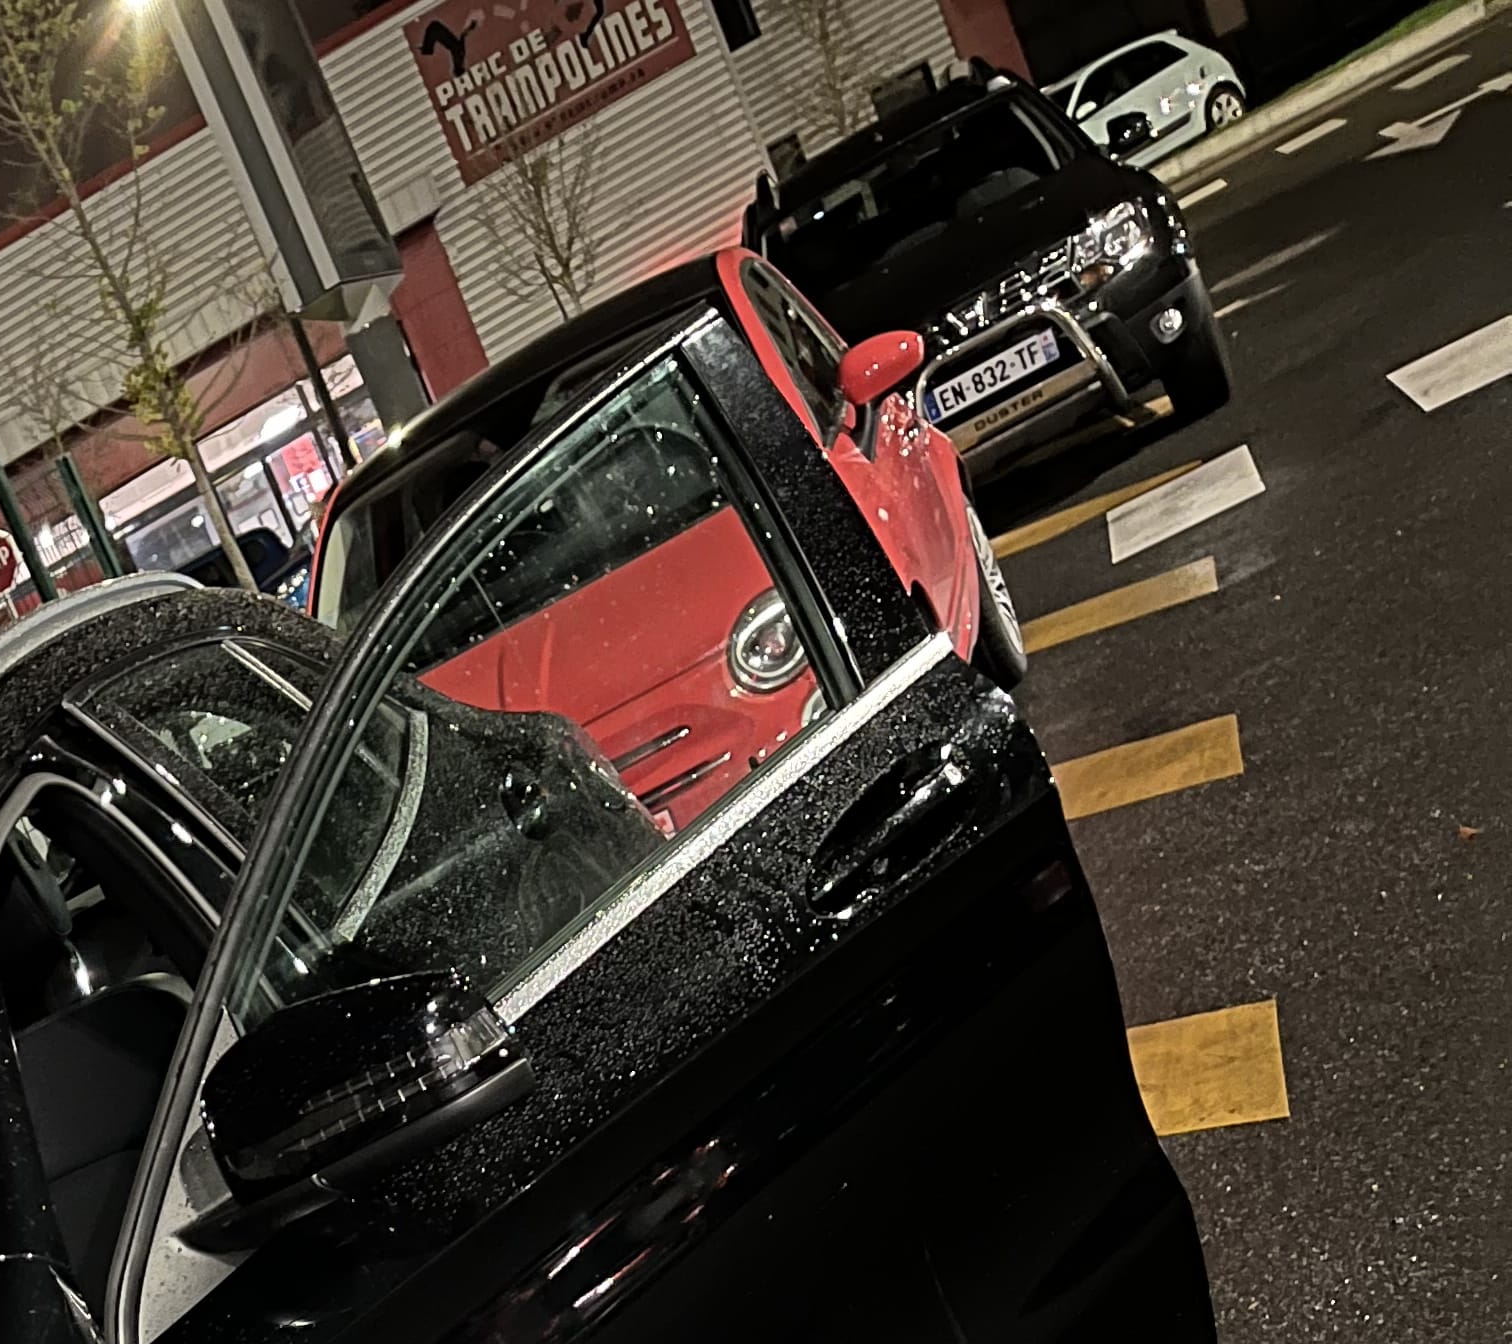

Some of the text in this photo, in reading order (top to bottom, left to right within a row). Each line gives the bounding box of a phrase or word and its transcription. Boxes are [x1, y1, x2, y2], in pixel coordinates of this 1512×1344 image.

[435, 28, 548, 107] PARC DE
[445, 0, 674, 152] TRAMPOLINES
[938, 340, 1038, 412] EN-832-TF
[974, 389, 1044, 432] DUSTER
